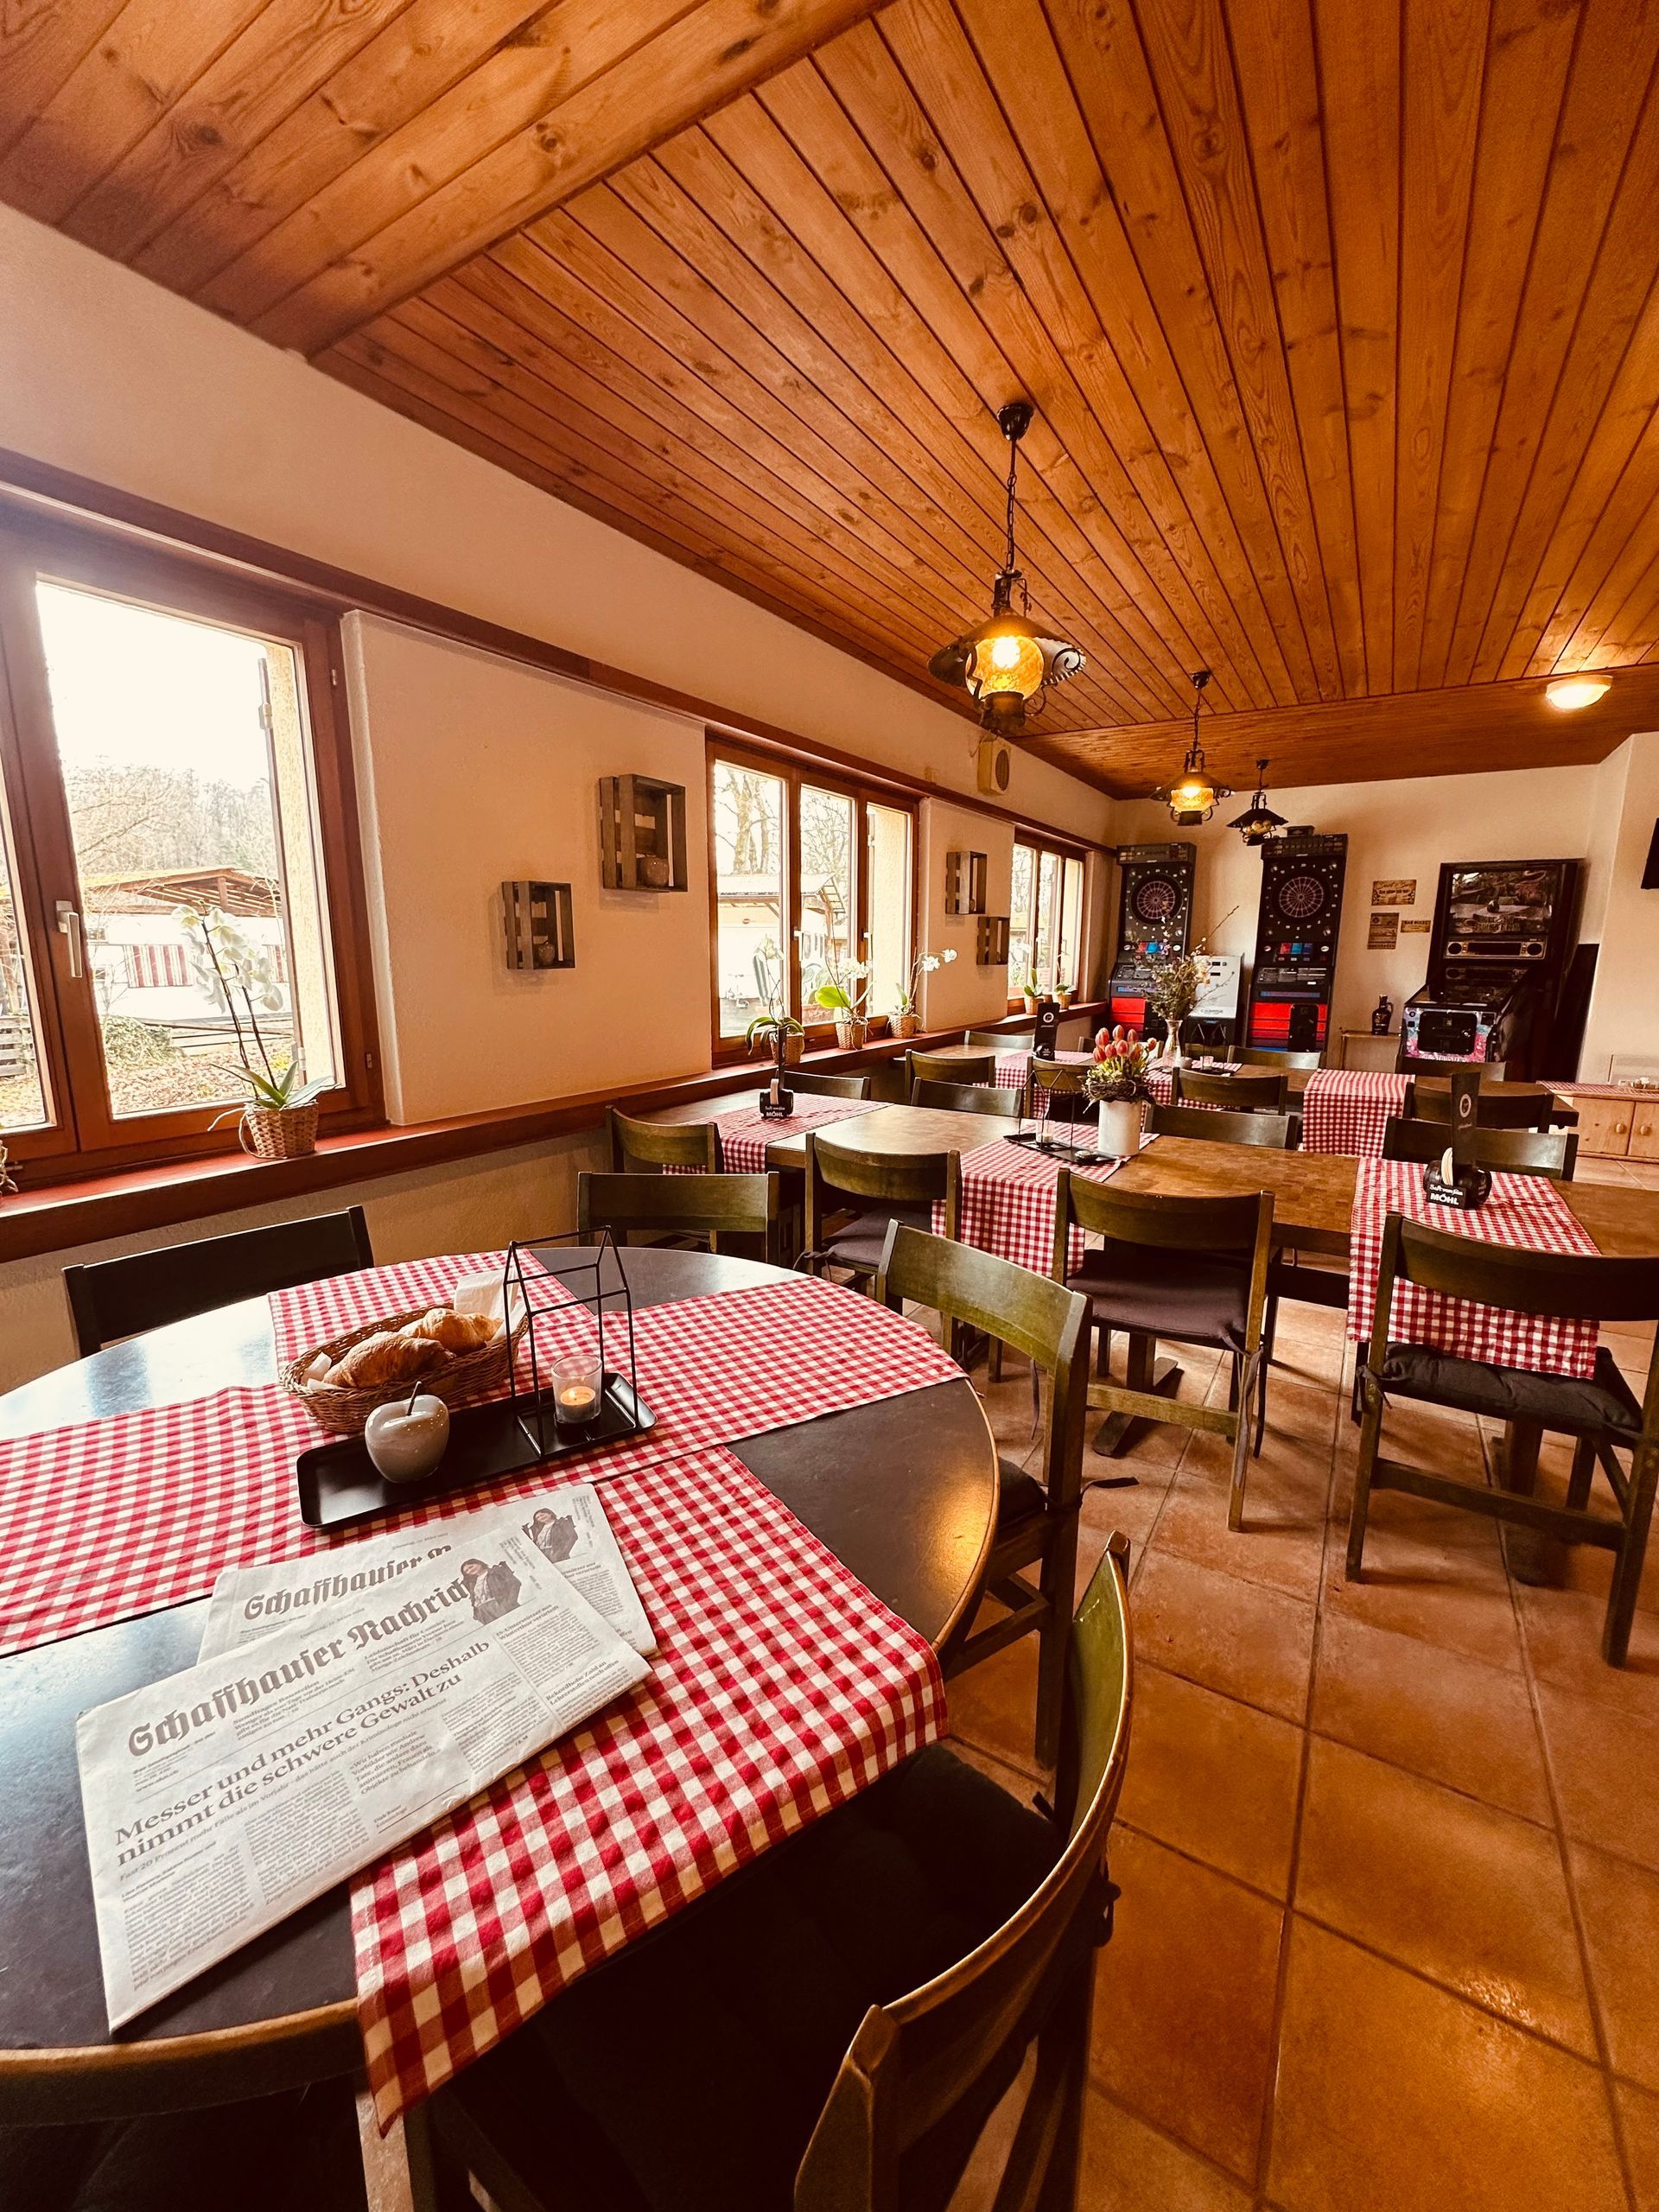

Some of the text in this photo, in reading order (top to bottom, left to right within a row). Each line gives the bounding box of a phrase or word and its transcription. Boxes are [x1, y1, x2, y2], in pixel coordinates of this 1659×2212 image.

[1430, 1192, 1459, 1205] MÖHL
[129, 1638, 346, 1757] Schaffhauser
[115, 1785, 213, 1847] Messer
[217, 1753, 268, 1790] und
[267, 1720, 333, 1762] mehr
[336, 1682, 410, 1725] Gangs:
[410, 1642, 490, 1688] Deshalb
[352, 1733, 427, 1776] Vorbilder wie Andrew
[367, 1744, 390, 1761] haben
[390, 1730, 418, 1746] mediale
[374, 1761, 385, 1771] die
[385, 1749, 410, 1765] andere
[409, 1740, 427, 1753] dazu
[397, 1750, 423, 1765] Frauen
[423, 1744, 433, 1754] als
[118, 1804, 216, 1866] nimmt
[219, 1781, 258, 1809] die
[262, 1727, 358, 1787] schwere
[360, 1686, 437, 1729] Gewalt
[438, 1674, 462, 1694] zu
[360, 1774, 390, 1796] Objekte
[391, 1769, 400, 1778] zu
[120, 1866, 138, 1881] Fast
[141, 1859, 153, 1871] 20
[155, 1840, 189, 1863] Prozent
[190, 1826, 213, 1843] mehr
[214, 1814, 235, 1828] Fälle
[235, 1805, 248, 1818] als
[248, 1800, 259, 1810] im
[260, 1782, 289, 1801] Vorjahr
[329, 1749, 346, 1763] auch
